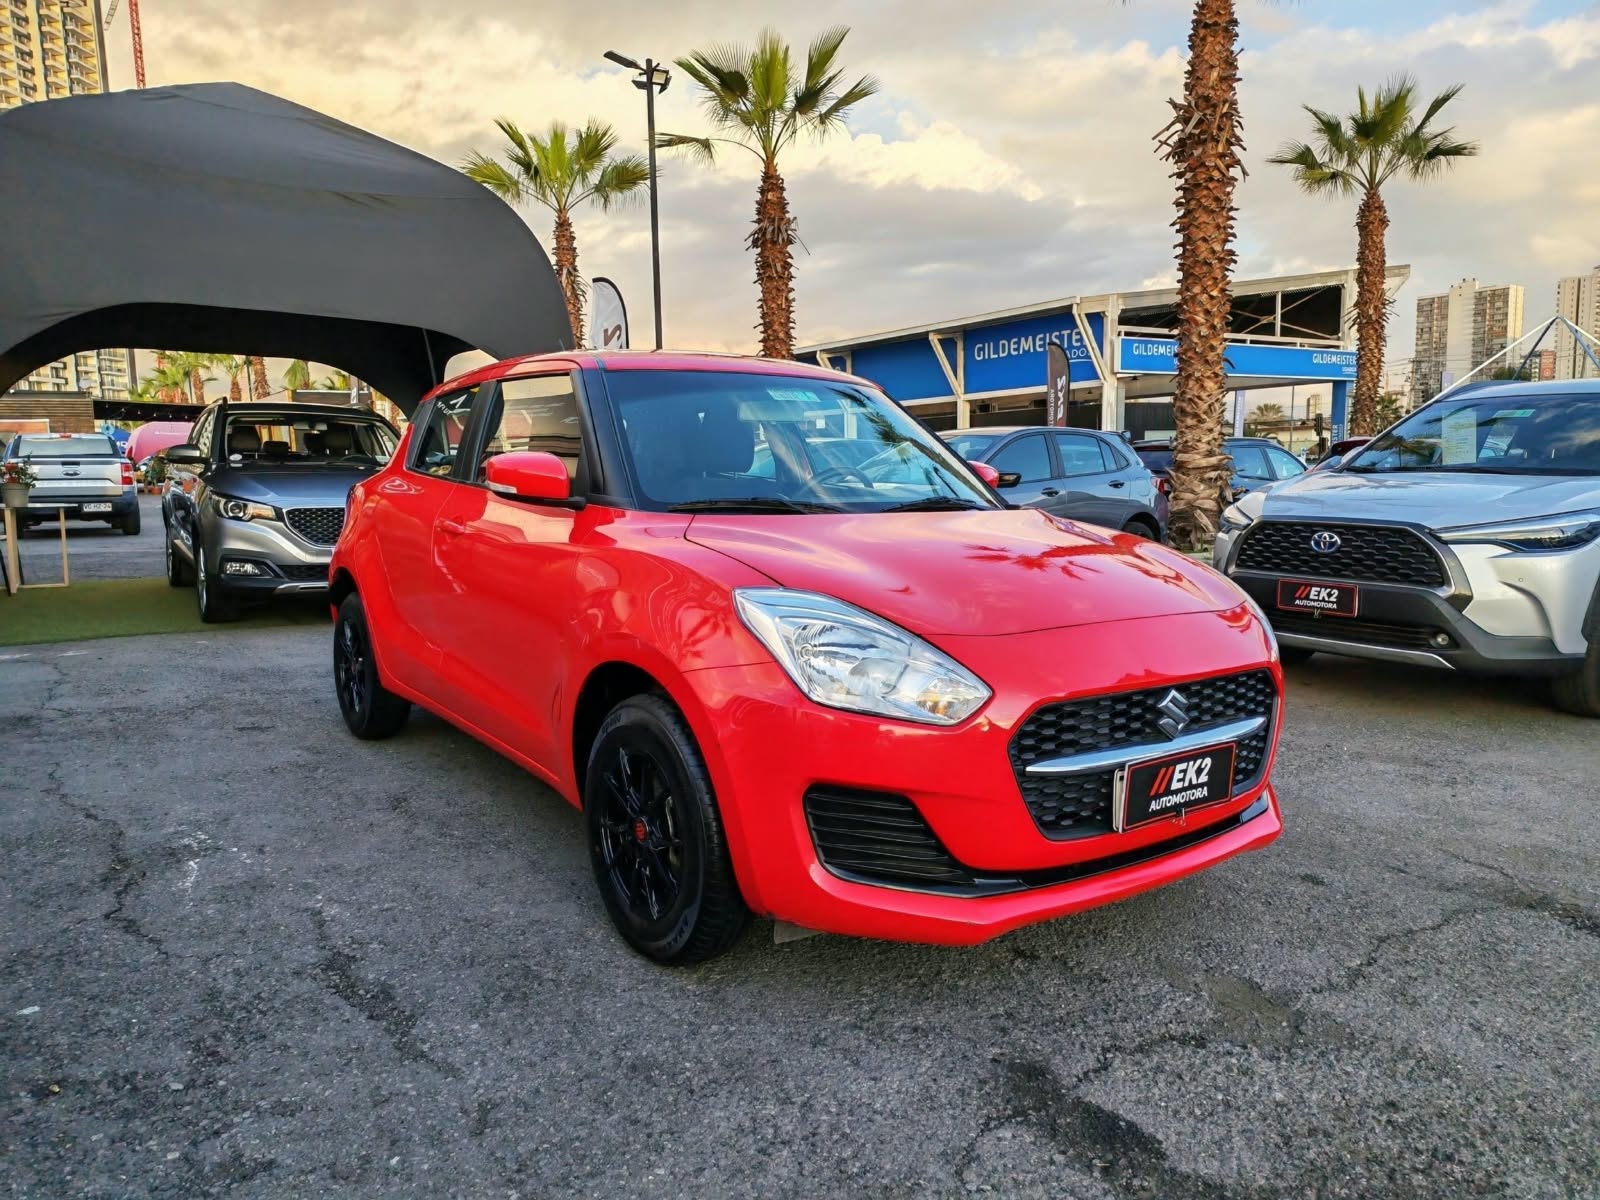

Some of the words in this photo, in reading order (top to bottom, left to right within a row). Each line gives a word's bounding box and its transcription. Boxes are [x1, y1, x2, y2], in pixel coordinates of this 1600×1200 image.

[974, 327, 1086, 361] GILDEMEISTE
[1294, 599, 1337, 609] AUTOMOTORA
[1149, 786, 1208, 812] AUTOMOTORA
